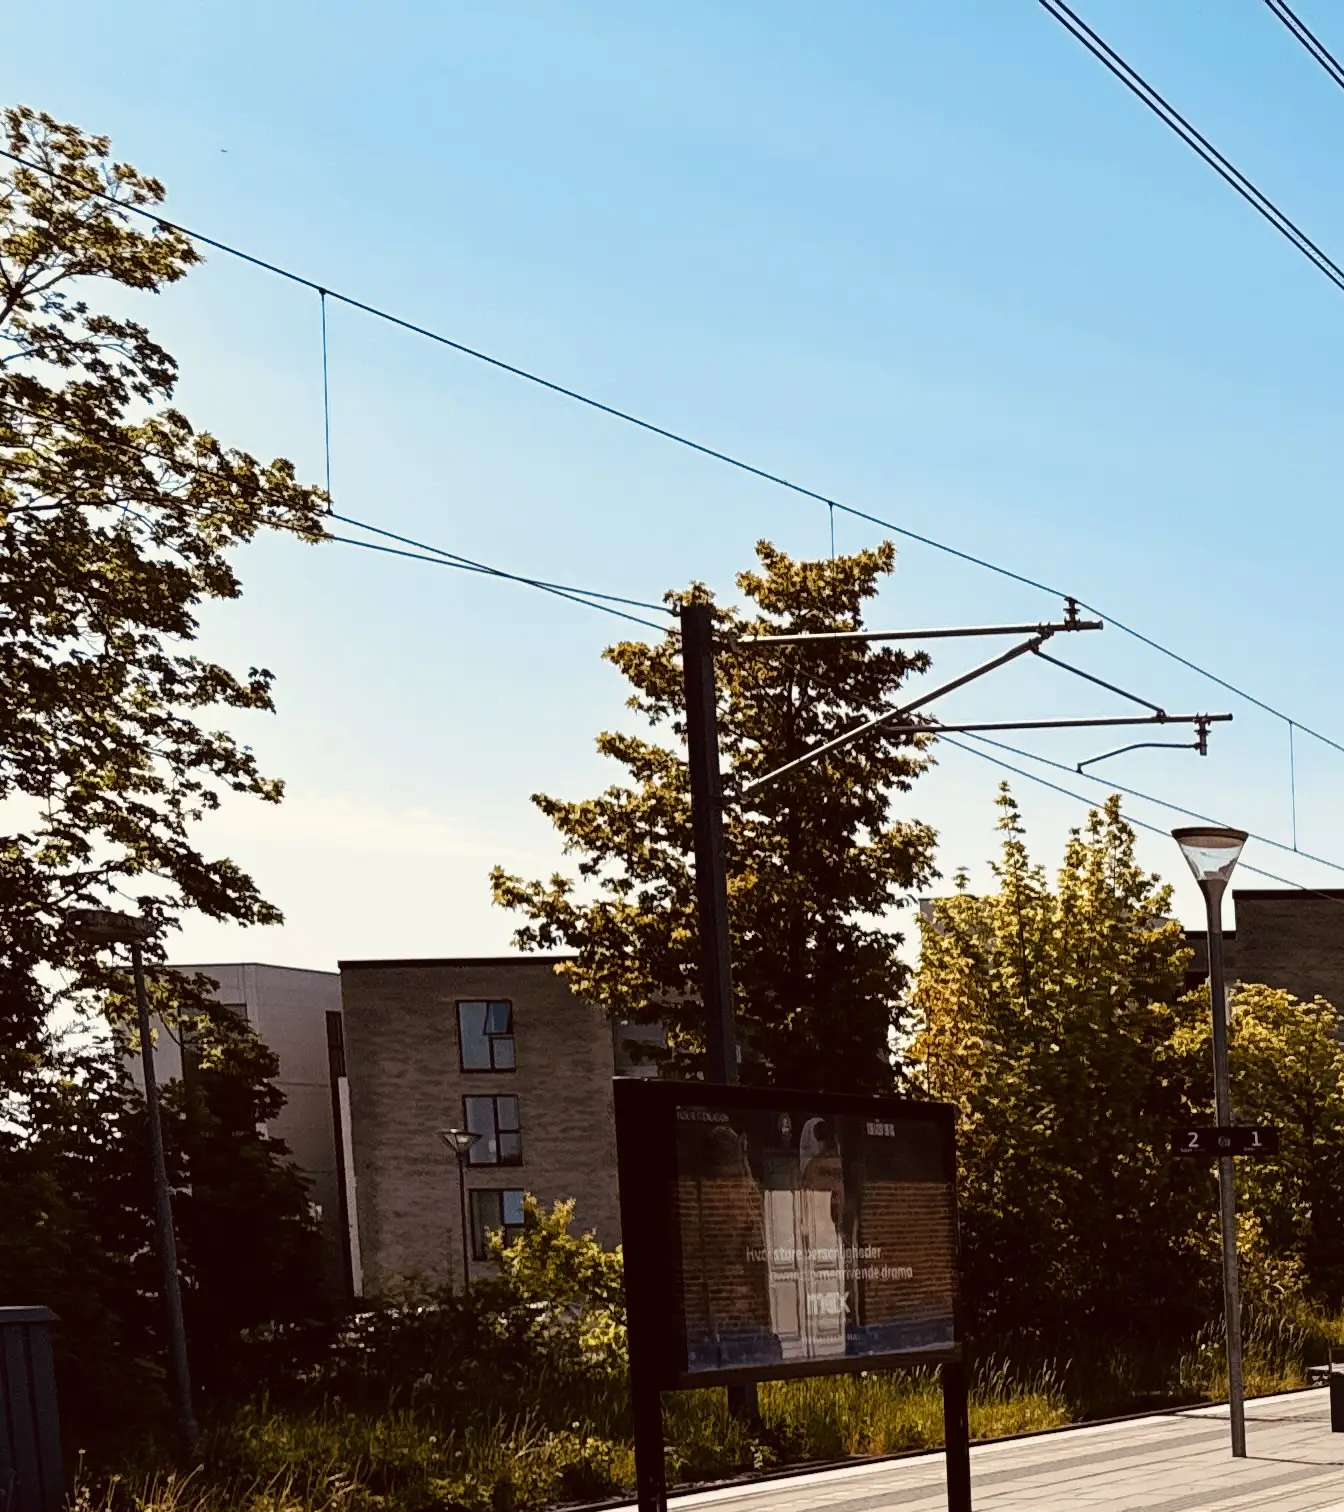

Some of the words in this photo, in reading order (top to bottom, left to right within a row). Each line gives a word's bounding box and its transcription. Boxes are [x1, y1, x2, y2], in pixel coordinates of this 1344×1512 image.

[1188, 1132, 1200, 1148] 2
[1252, 1131, 1263, 1146] 1
[881, 1264, 913, 1280] drama
